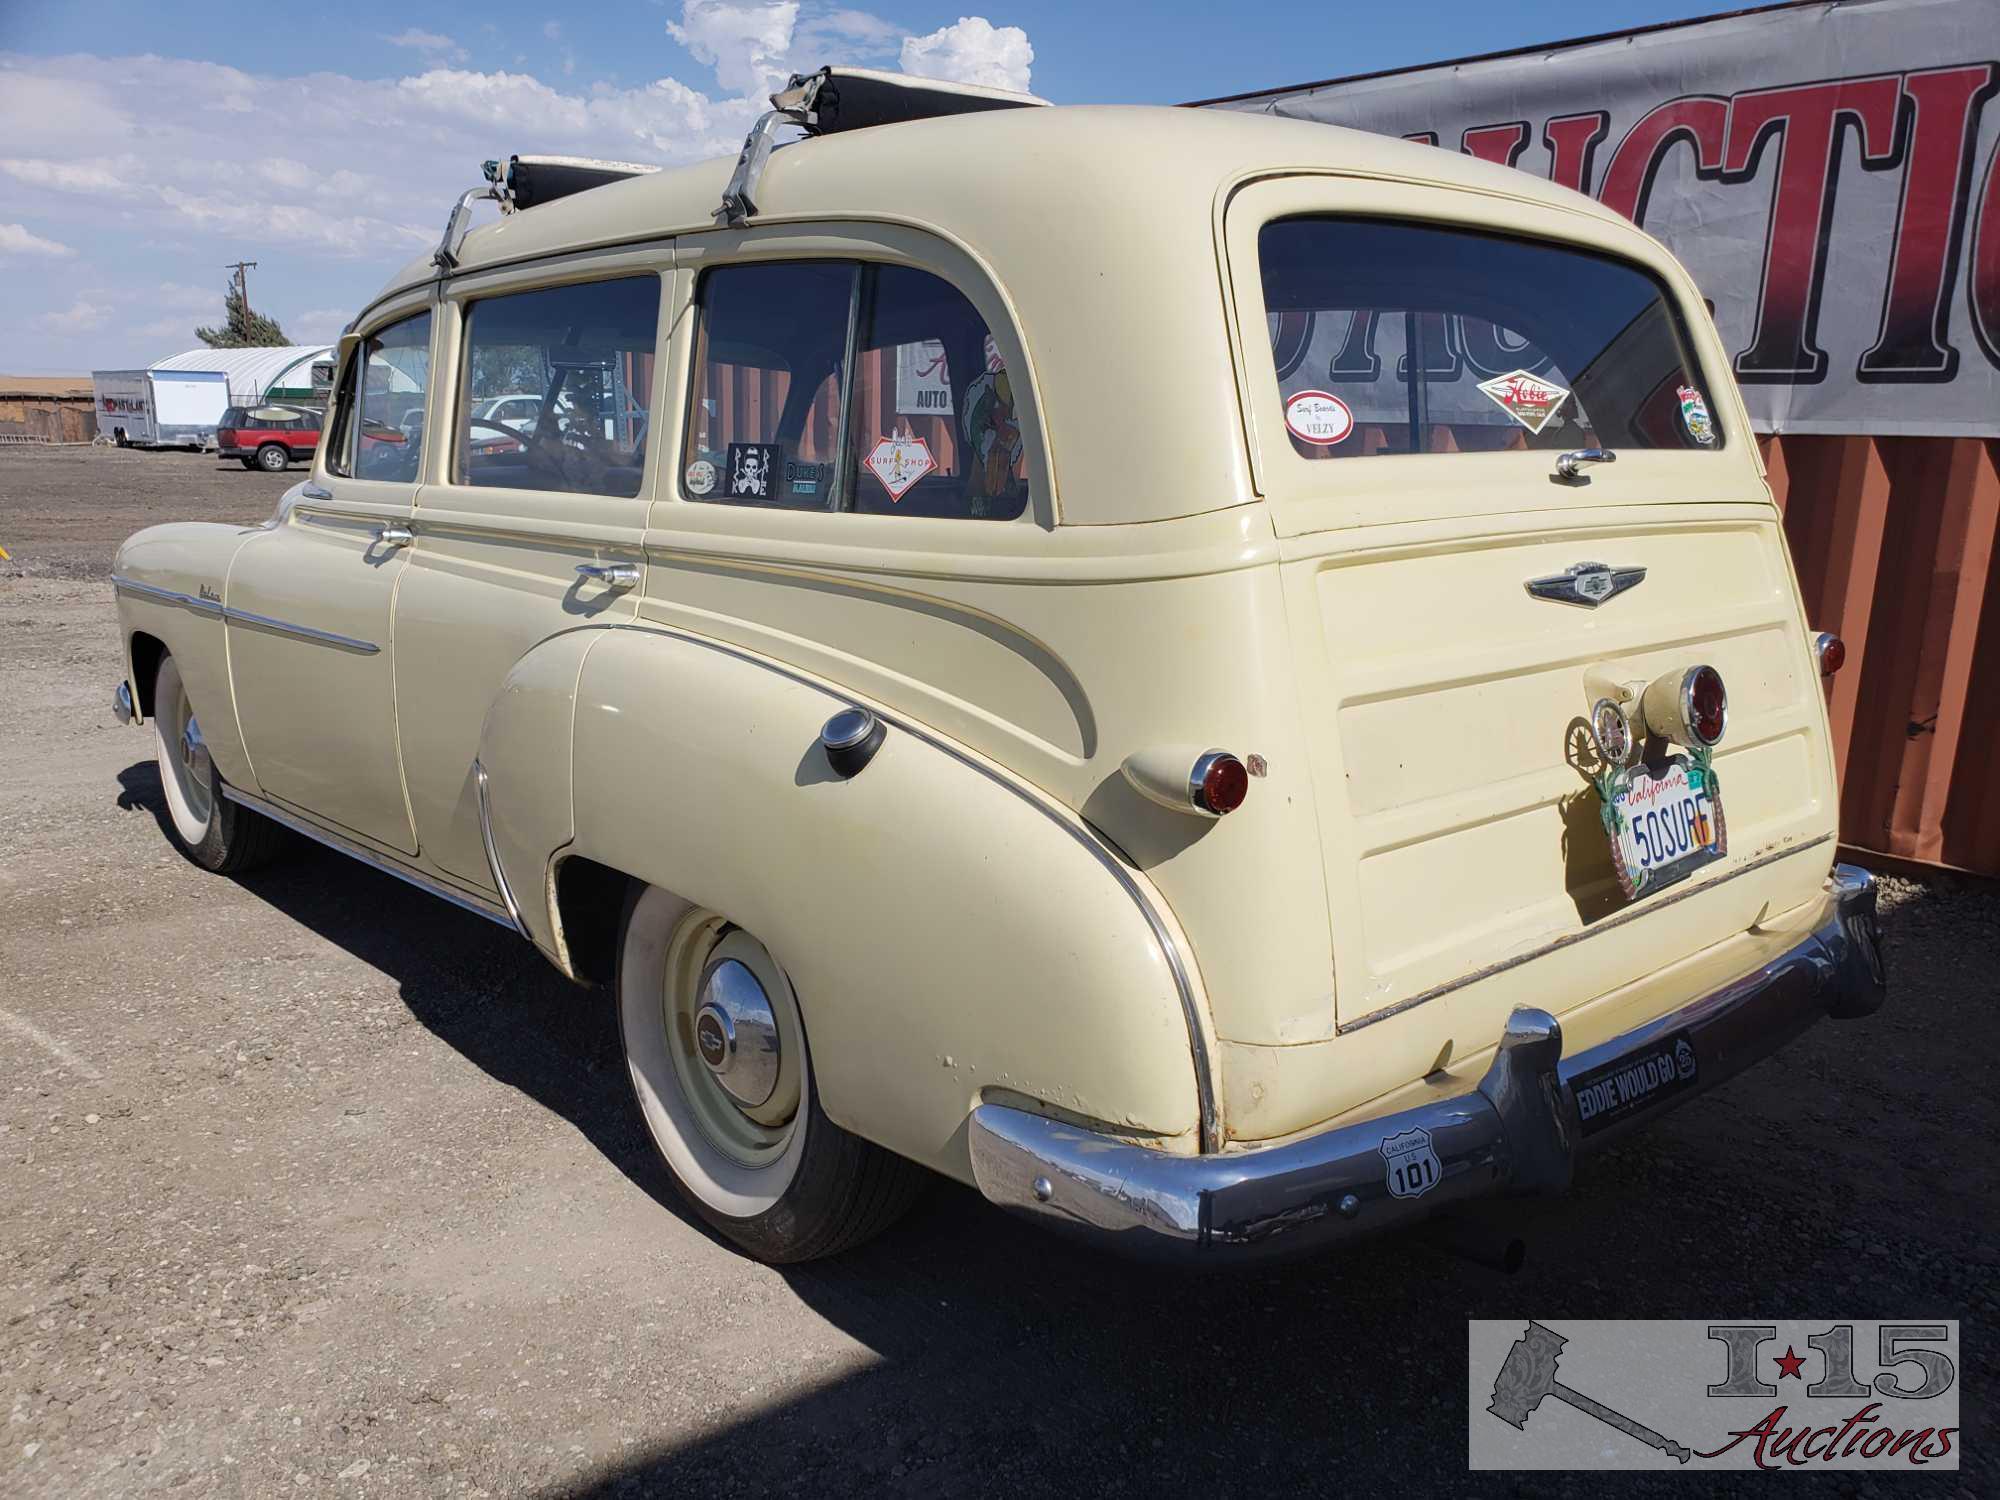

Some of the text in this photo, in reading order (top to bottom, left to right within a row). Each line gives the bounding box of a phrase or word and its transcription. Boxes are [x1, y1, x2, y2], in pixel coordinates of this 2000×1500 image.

[1400, 62, 2000, 385] UCTI
[916, 390, 948, 408] AUTO
[1503, 377, 1549, 404] Hobie
[1306, 423, 1335, 434] VELZY
[904, 457, 930, 468] SHOP
[1628, 772, 1689, 807] California
[1631, 792, 1712, 867] 50SURF
[1576, 1079, 1618, 1121] EDDIE
[1615, 1061, 1659, 1104] WOULD
[1657, 1053, 1676, 1086] GO
[1386, 1135, 1426, 1154] CALIFORNIA
[1395, 1158, 1433, 1193] 101
